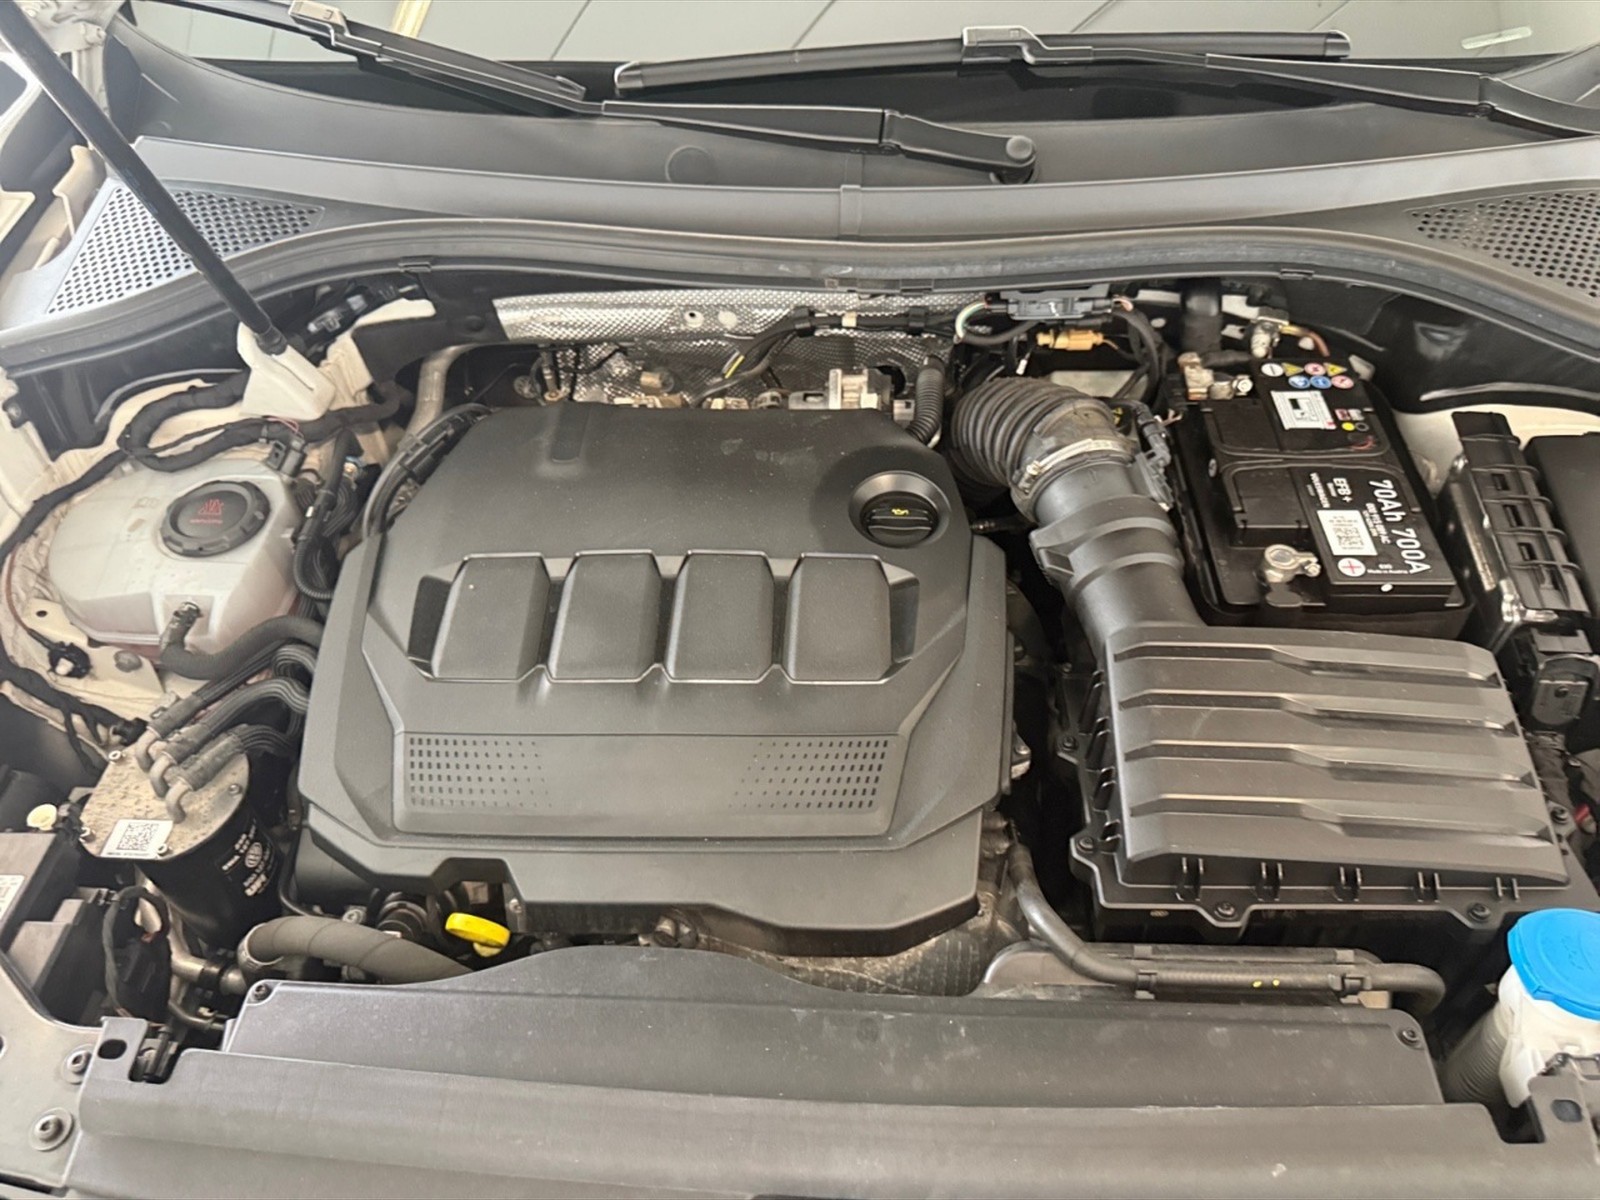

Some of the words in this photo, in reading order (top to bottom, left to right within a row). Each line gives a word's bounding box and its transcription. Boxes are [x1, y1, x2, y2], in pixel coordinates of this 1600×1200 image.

[1333, 478, 1352, 495] EFB
[1369, 479, 1406, 522] 70Ah
[1391, 528, 1431, 574] 700A
